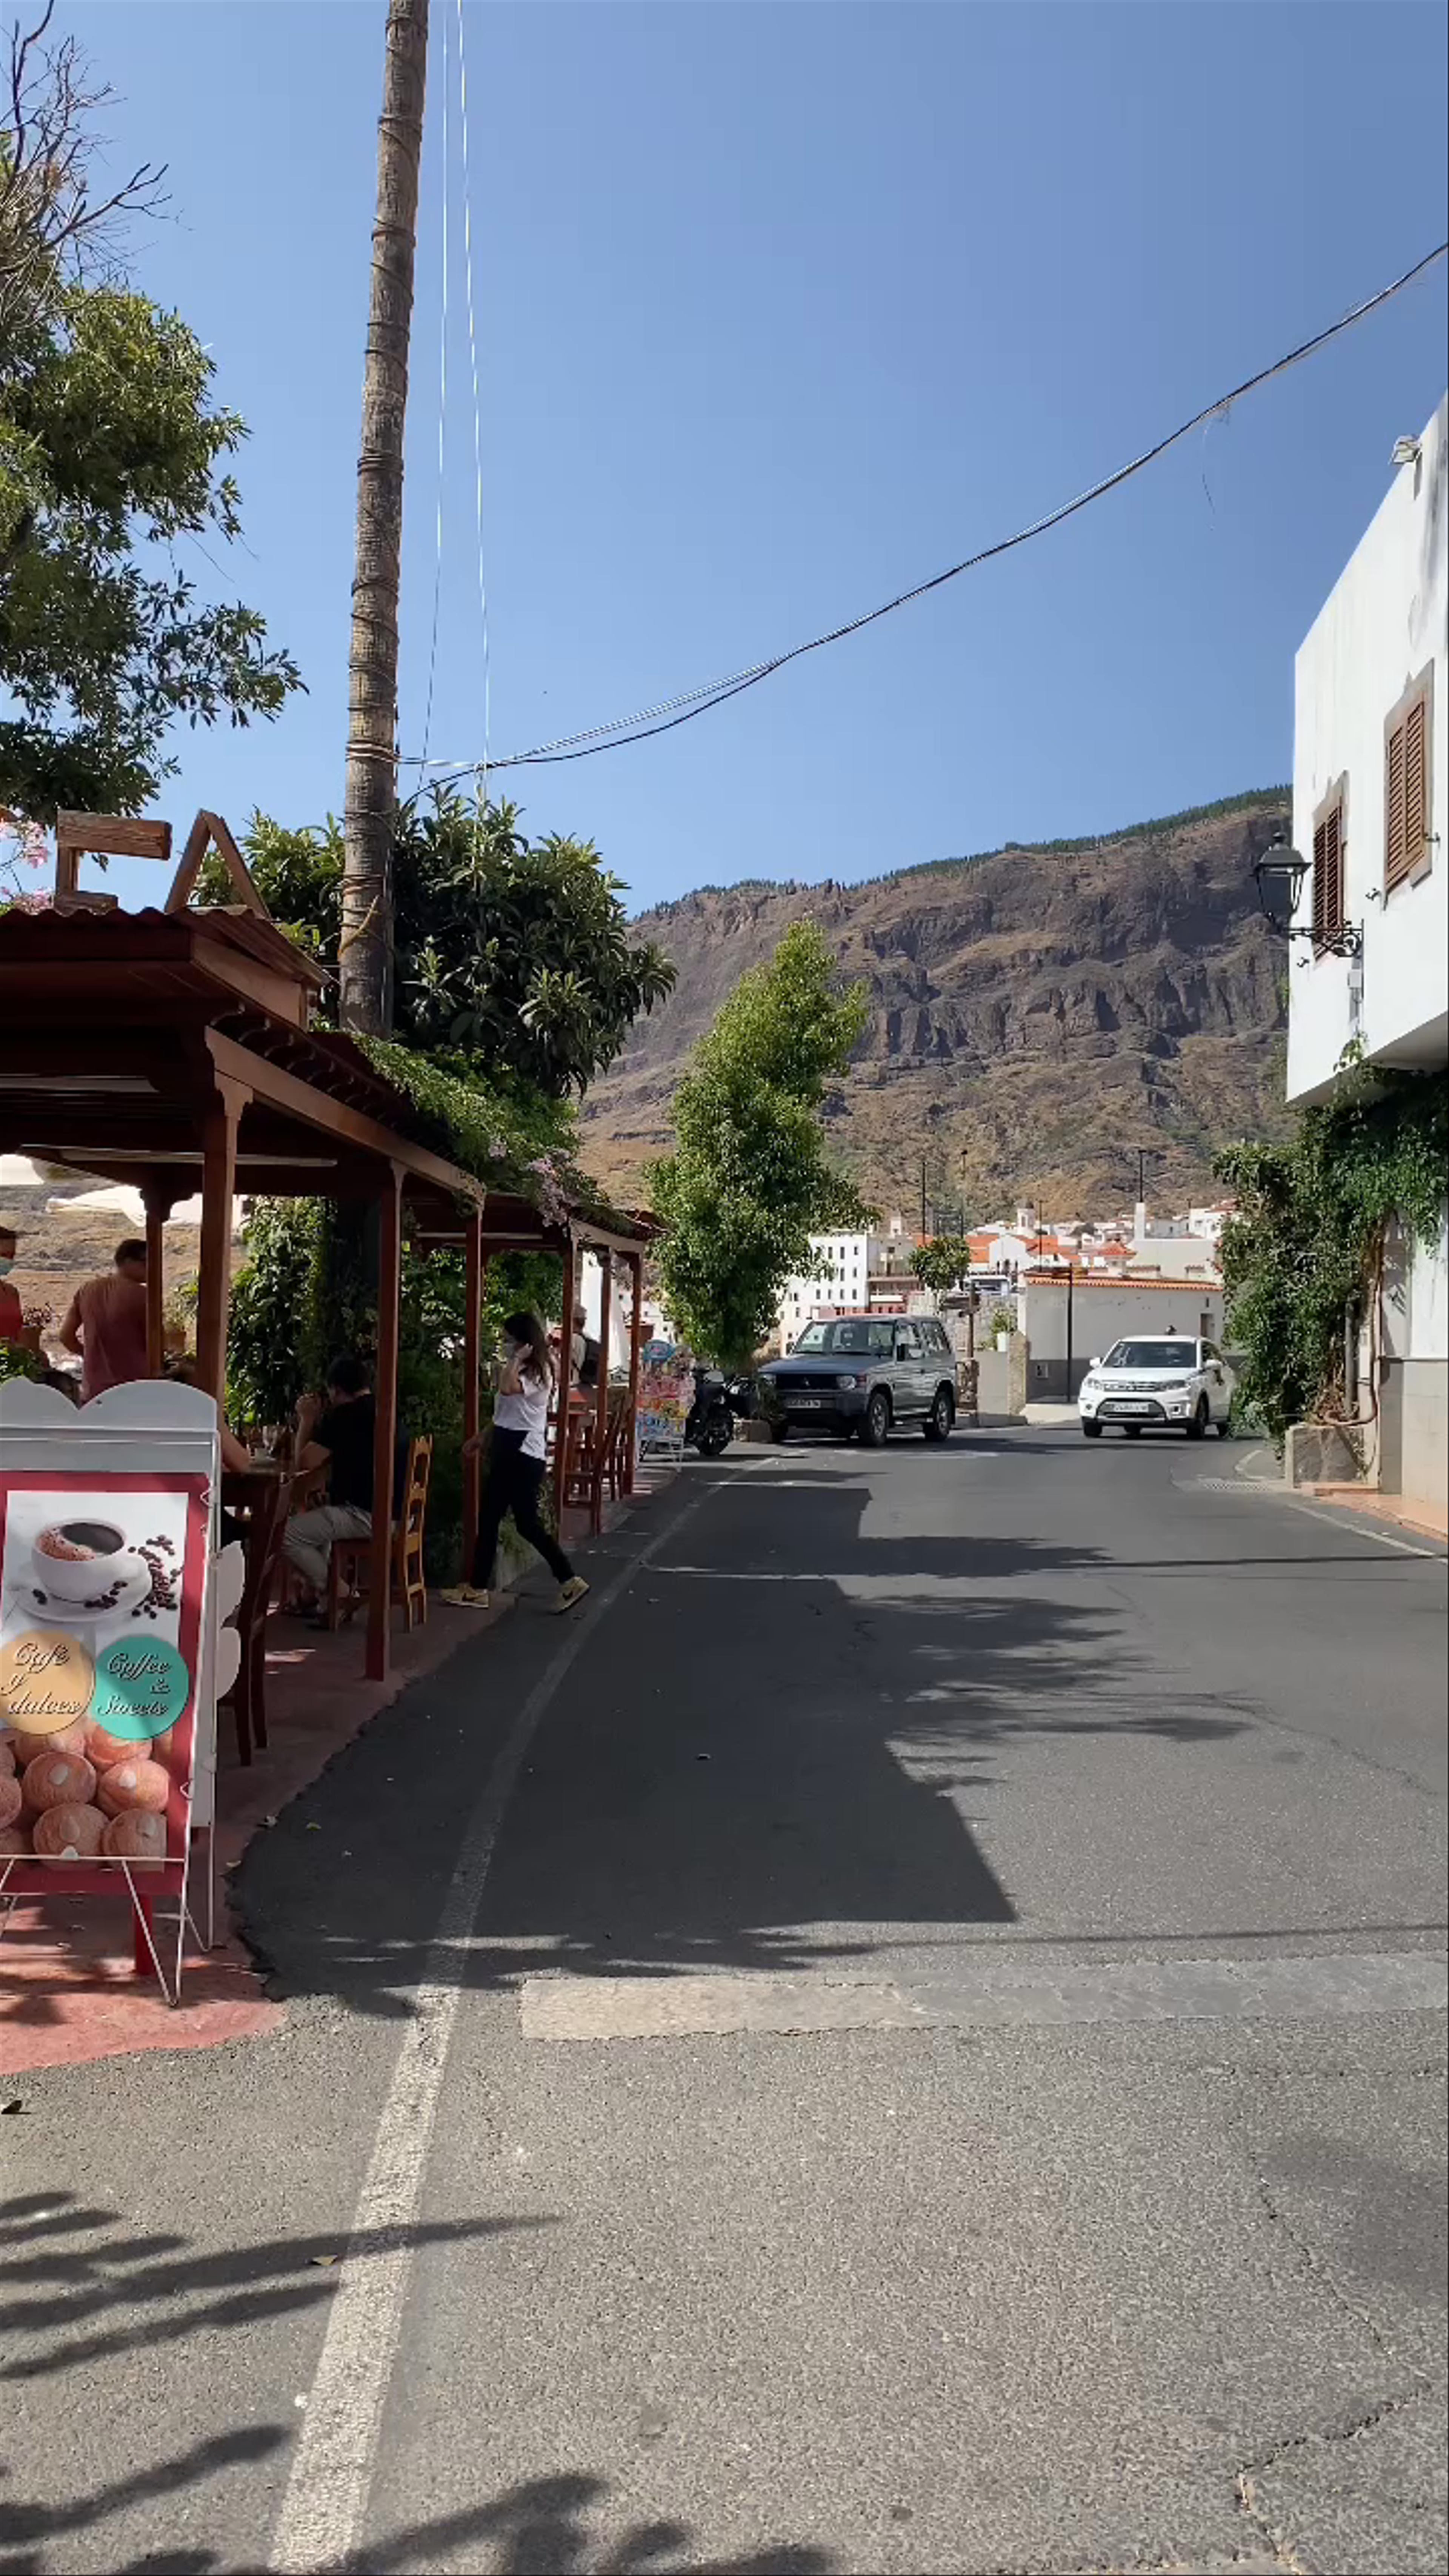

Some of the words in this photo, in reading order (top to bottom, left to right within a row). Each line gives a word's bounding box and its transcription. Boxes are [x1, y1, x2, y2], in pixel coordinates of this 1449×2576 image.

[108, 1653, 171, 1680] Coffee
[0, 1673, 28, 1696] y
[150, 1679, 171, 1693] &
[8, 1691, 81, 1714] dulces
[96, 1695, 169, 1716] Sweets
